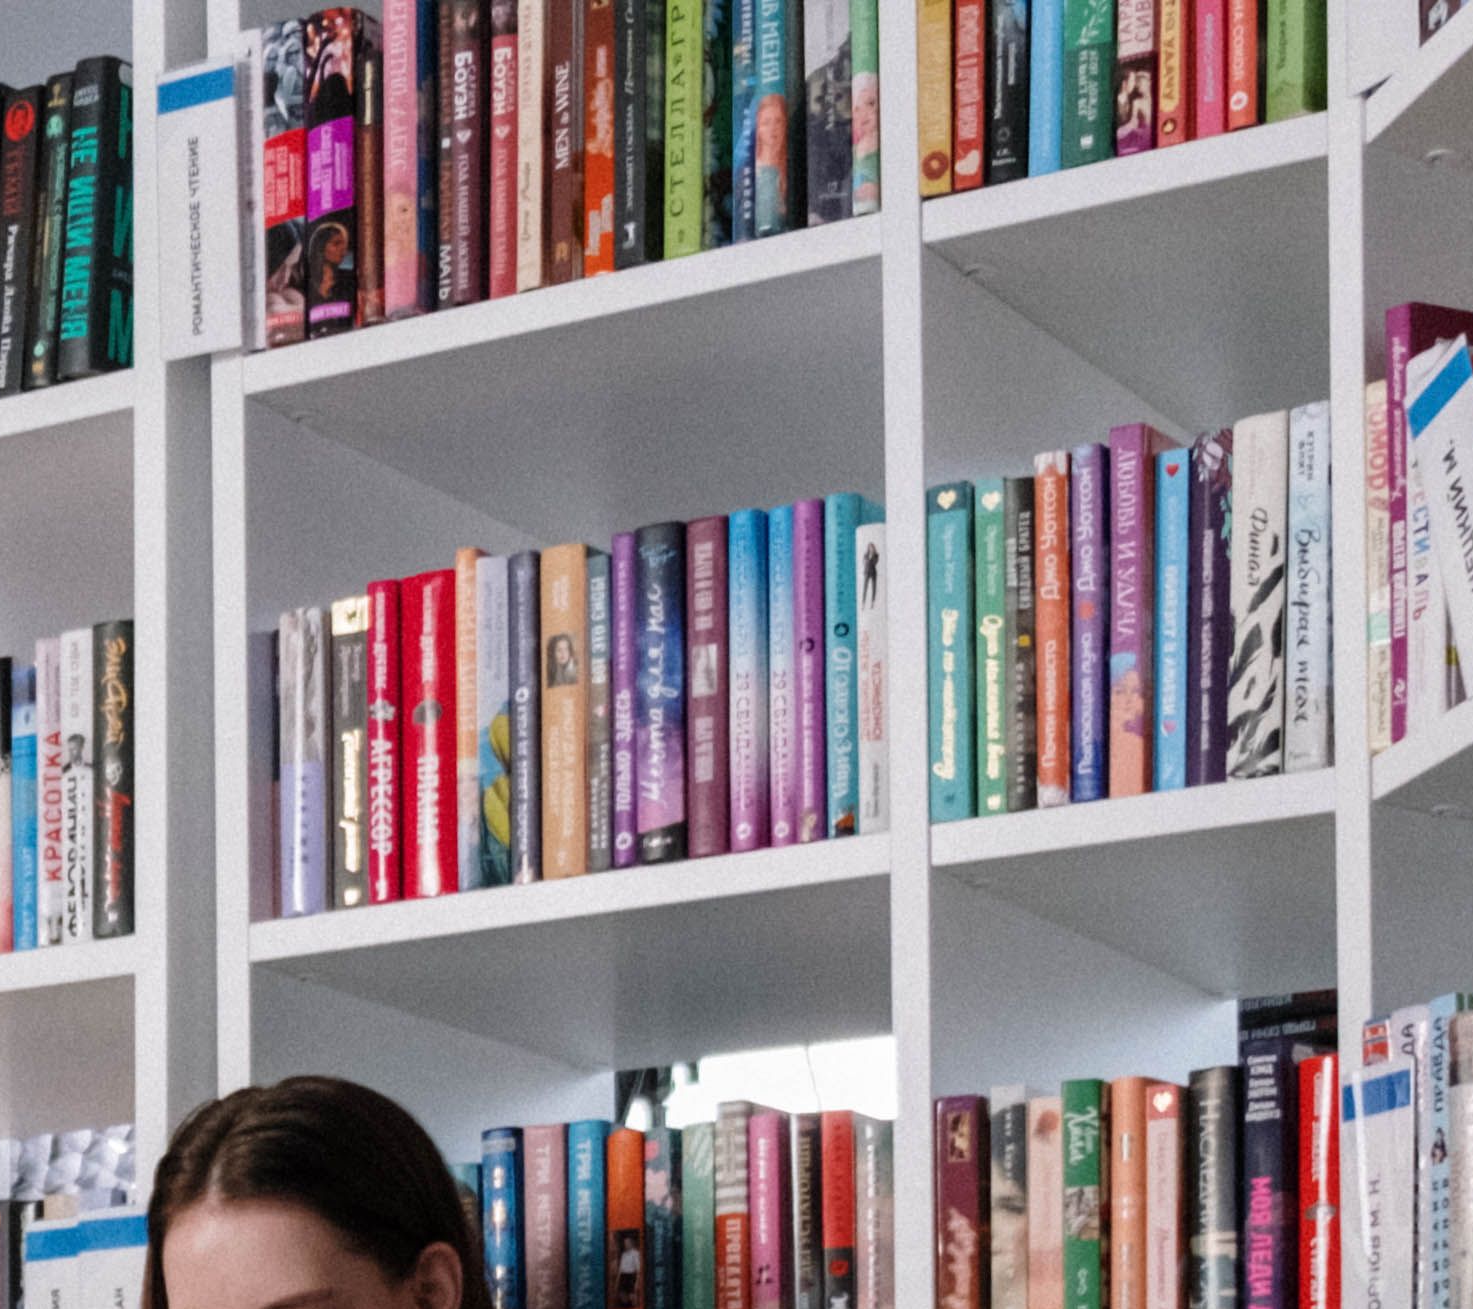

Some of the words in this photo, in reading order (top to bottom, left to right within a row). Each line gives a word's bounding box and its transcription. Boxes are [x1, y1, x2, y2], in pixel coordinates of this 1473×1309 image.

[454, 49, 473, 121] БОУЭН
[493, 45, 513, 117] БОУЭН
[555, 61, 571, 113] WINE
[72, 125, 98, 165] НЕ
[188, 136, 199, 197] ЧТЕНИЕ
[555, 128, 571, 170] MEN
[670, 69, 687, 218] СТЕЛЛА
[66, 175, 97, 248] ИЩИ
[61, 255, 91, 340] МЕНЯ
[190, 203, 202, 336] РОМАНТИЧЕСКОЕ
[1116, 446, 1138, 535] ЛЮБОВЬ
[1441, 438, 1458, 476] М.
[1040, 476, 1058, 551] Уотсон
[1076, 466, 1094, 541] Уотсон
[1041, 554, 1061, 600] Джо
[1076, 544, 1095, 592] Джо
[1116, 541, 1137, 560] И
[1247, 506, 1270, 589] Финал
[646, 583, 665, 635] нас
[1116, 567, 1137, 644] УДАЧА
[1291, 527, 1322, 651] Выбирая
[642, 642, 679, 699] для
[872, 660, 883, 742] ЮМОРИСТА
[1293, 659, 1320, 729] тебя
[615, 688, 633, 743] ЗДЕСЬ
[616, 749, 632, 812] ТОЛЬКО
[640, 706, 668, 809] Мечта
[43, 730, 63, 882] КРАСОТКА
[370, 738, 393, 855] АГРЕССОР
[1431, 1016, 1446, 1114] ПРАВДА
[536, 1144, 551, 1185] ТРИ
[576, 1140, 592, 1181] ТРИ
[1368, 1172, 1381, 1196] Н.
[536, 1193, 552, 1262] МЕТРА
[576, 1188, 592, 1257] МЕТРА
[1250, 1176, 1274, 1228] МОЯ
[1368, 1203, 1382, 1229] М.
[576, 1263, 593, 1307] НАД
[1248, 1232, 1273, 1298] ЛЕДИ
